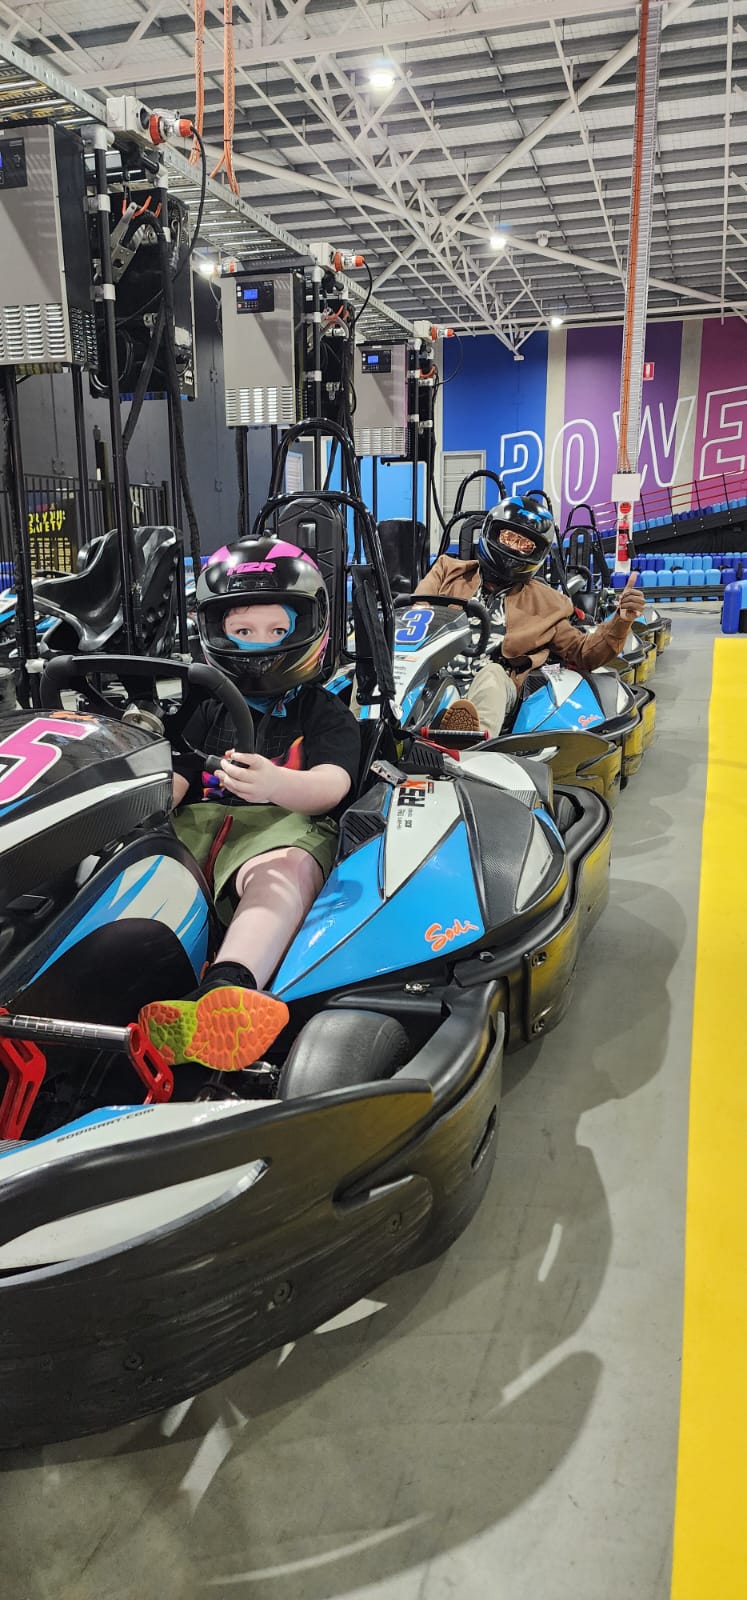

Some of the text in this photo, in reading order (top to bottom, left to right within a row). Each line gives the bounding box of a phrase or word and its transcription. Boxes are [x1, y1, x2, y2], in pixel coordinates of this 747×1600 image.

[395, 609, 435, 643] 3
[0, 717, 99, 805] 5
[424, 918, 480, 952] Sodi
